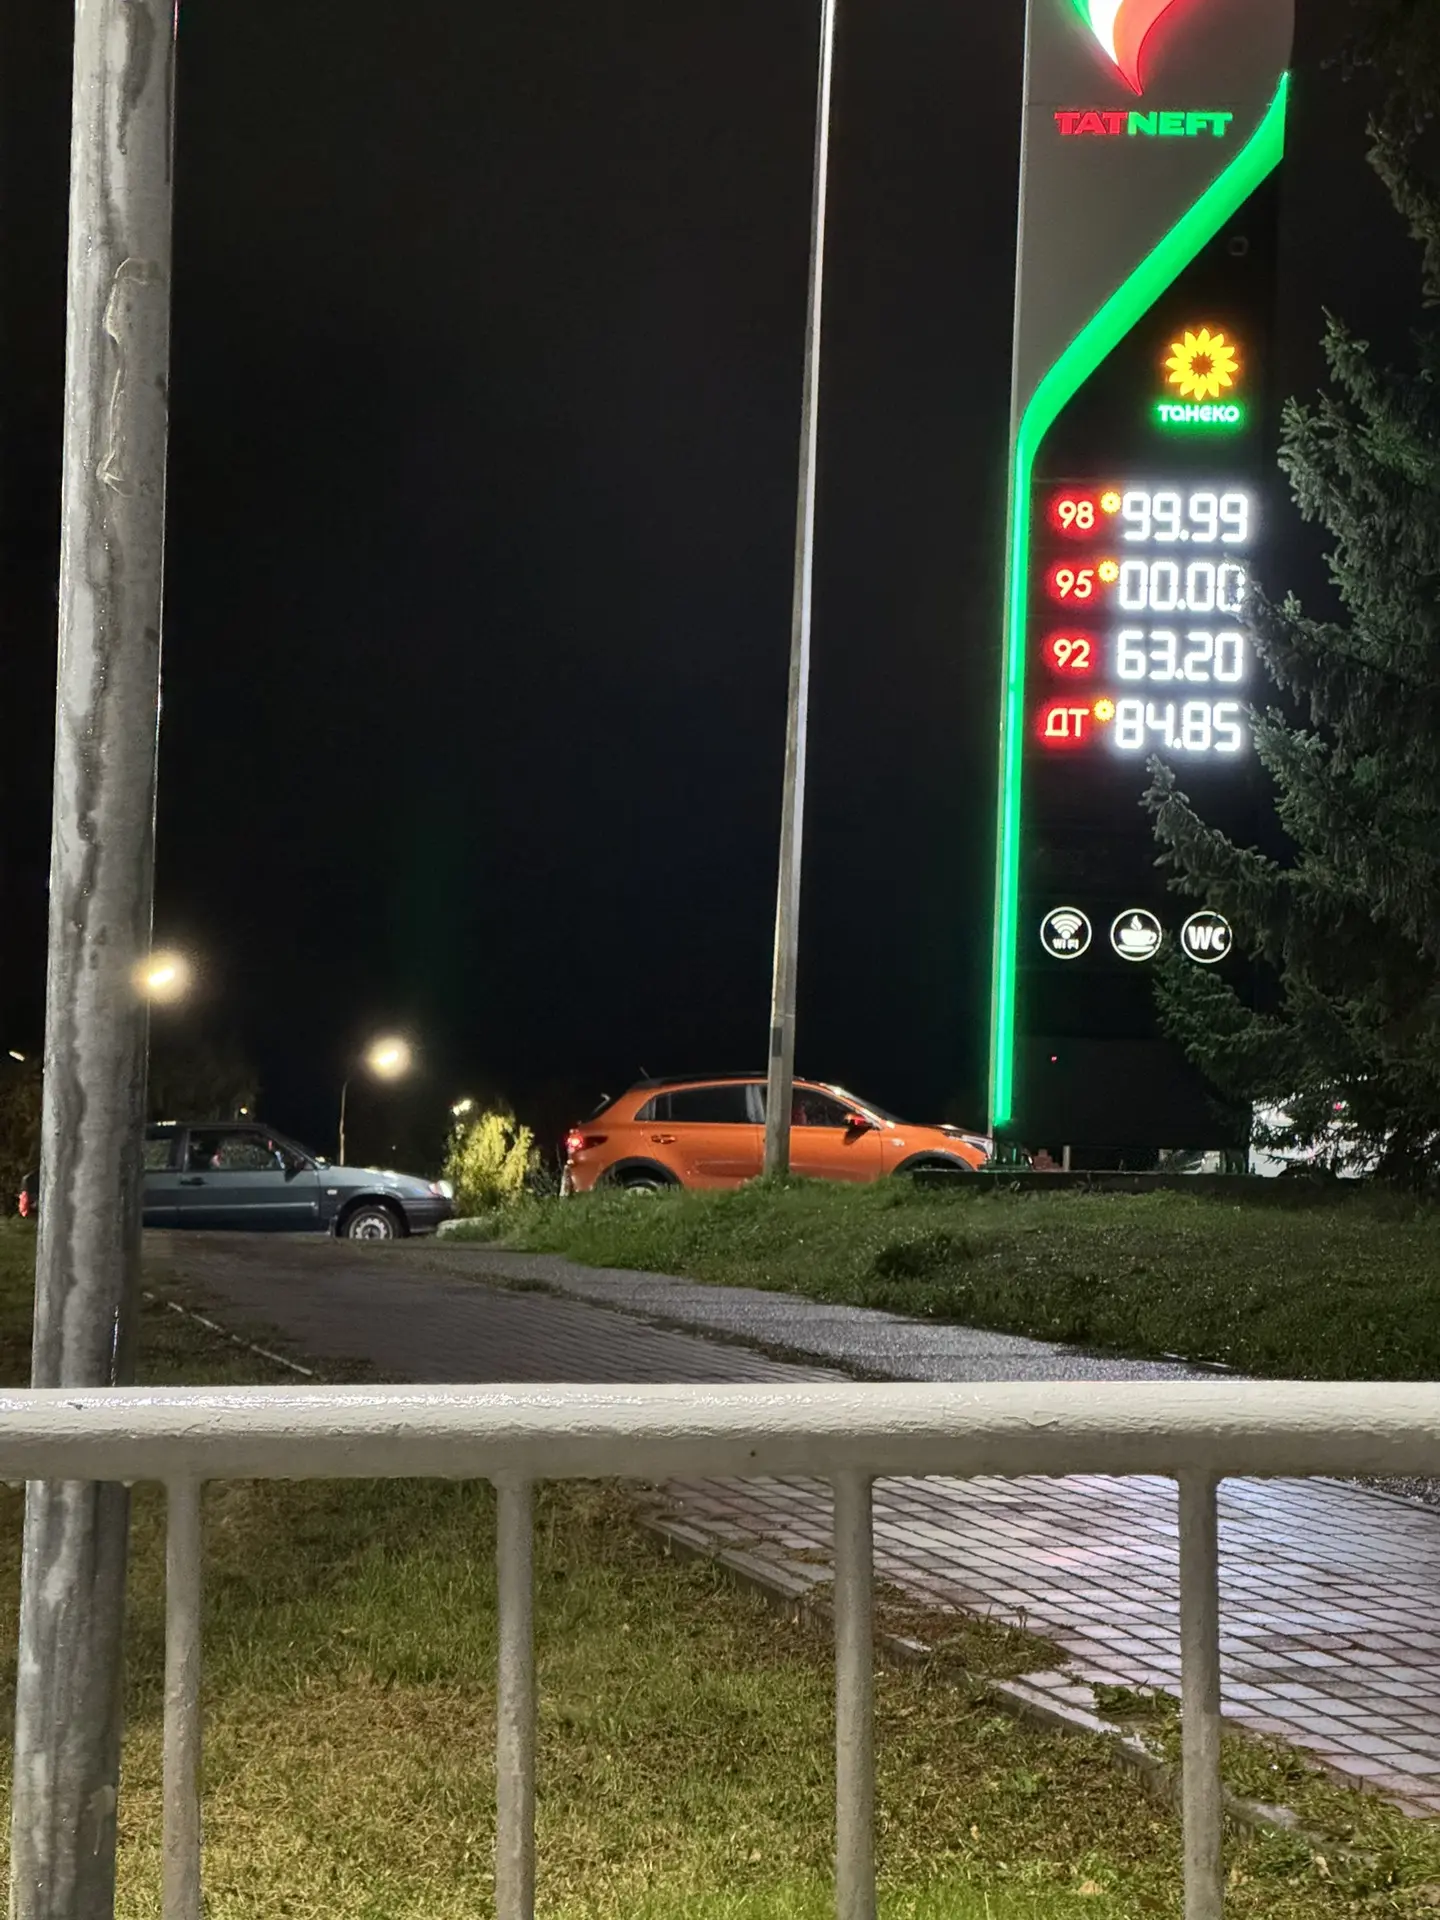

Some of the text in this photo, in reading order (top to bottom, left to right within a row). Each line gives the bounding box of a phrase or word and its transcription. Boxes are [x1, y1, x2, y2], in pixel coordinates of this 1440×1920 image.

[1054, 111, 1233, 136] TATNEFT
[1058, 491, 1249, 542] 98 99.99
[1055, 560, 1245, 612] 95 00.00
[1053, 630, 1244, 682] 92 63.20
[1045, 700, 1242, 751] ДТ 84.85
[1187, 926, 1226, 951] WC
